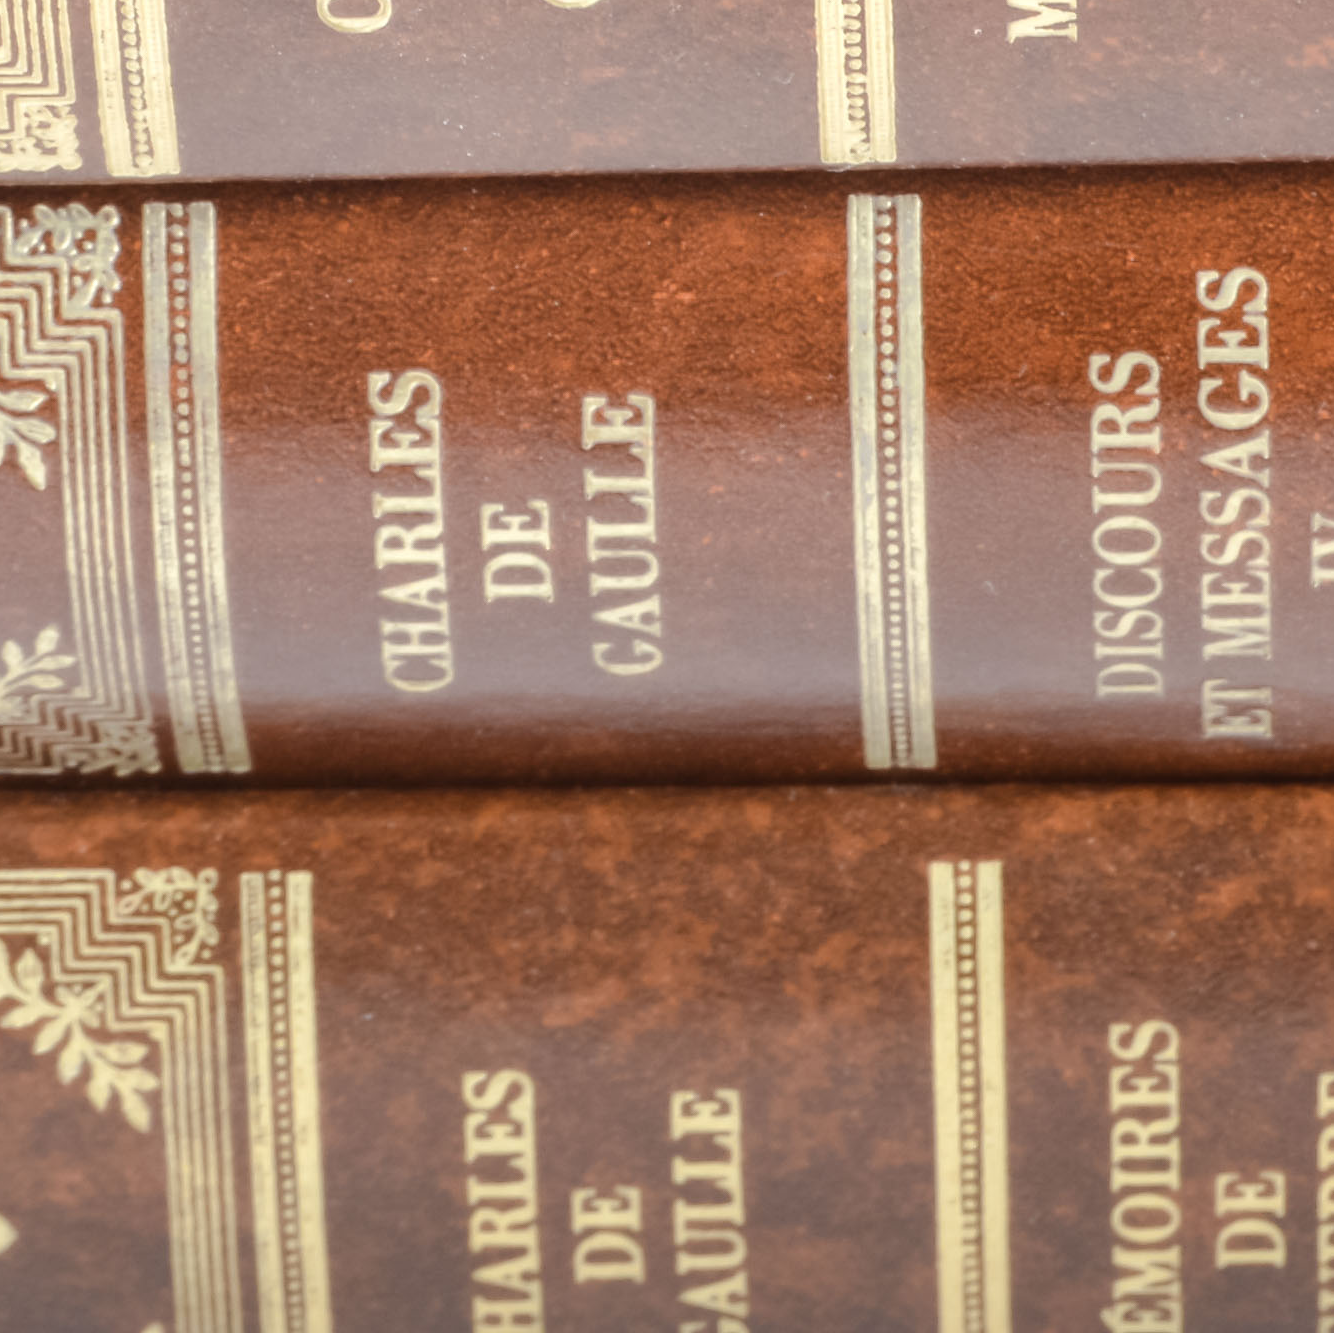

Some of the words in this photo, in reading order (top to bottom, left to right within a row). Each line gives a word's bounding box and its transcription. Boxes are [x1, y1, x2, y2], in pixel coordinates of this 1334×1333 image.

[367, 369, 455, 692] CHARLES
[481, 499, 554, 602] DE
[582, 393, 662, 676] GAULLE
[1089, 349, 1164, 699] DISCOURS
[1196, 267, 1270, 661] MESSAGES
[1203, 676, 1272, 739] ET
[462, 1069, 543, 1333] HARLES
[572, 1185, 645, 1285] DE
[673, 1088, 750, 1333] AULLE
[1100, 1019, 1181, 1333] ÉMOIRES
[1215, 1172, 1286, 1269] DE
